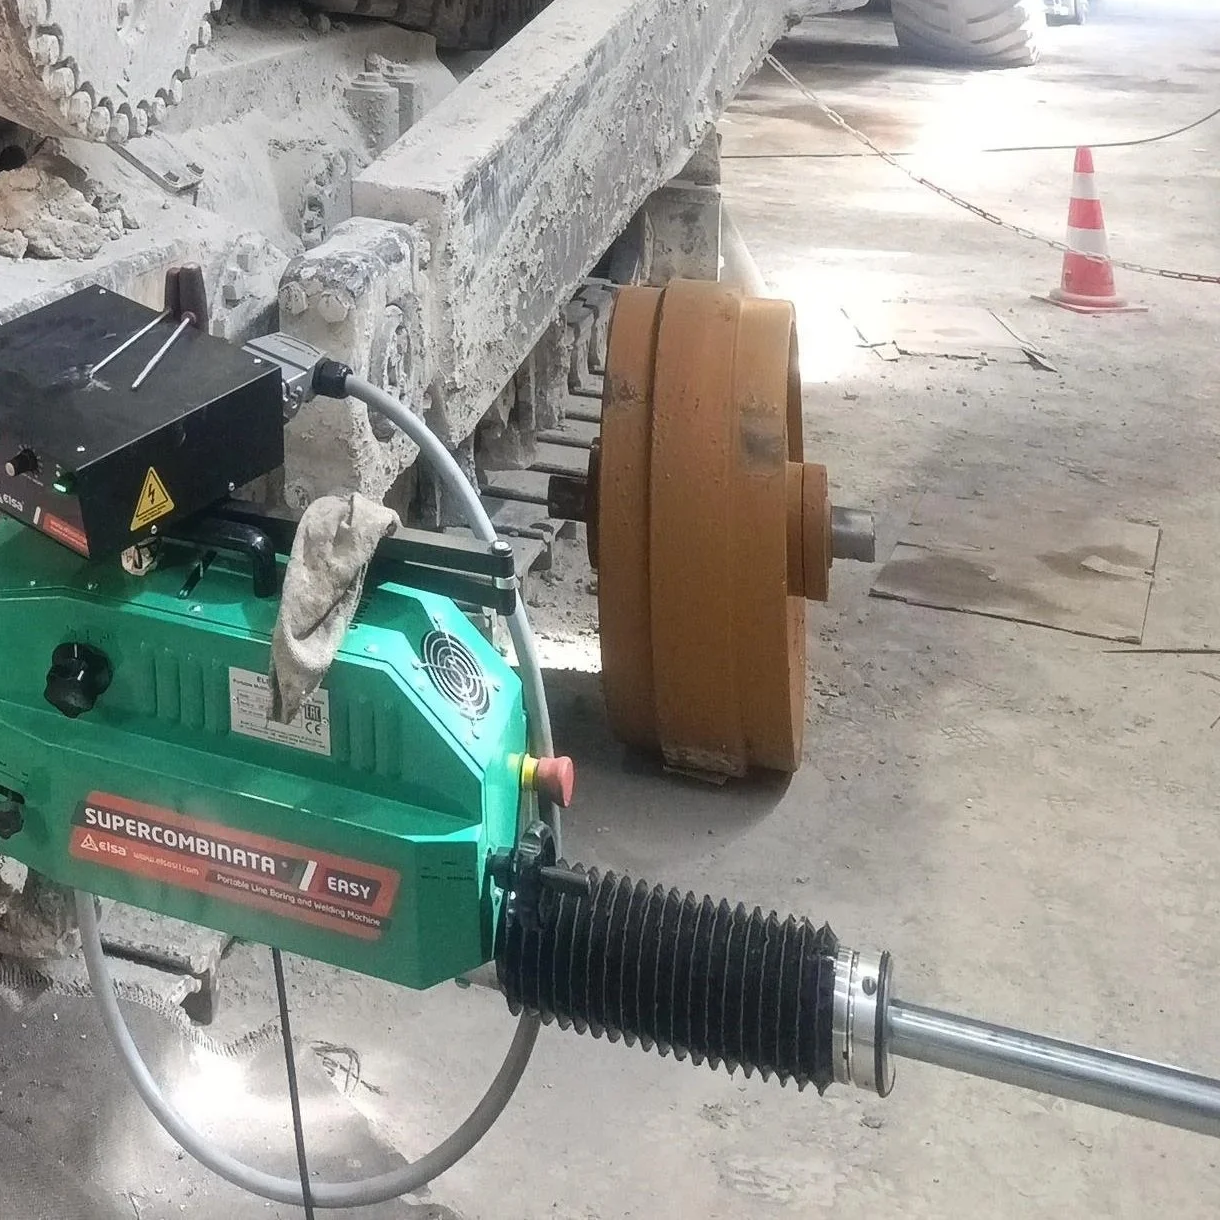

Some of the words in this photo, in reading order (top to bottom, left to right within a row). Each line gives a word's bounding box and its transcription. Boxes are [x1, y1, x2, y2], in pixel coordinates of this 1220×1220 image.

[84, 807, 276, 876] SUPERCOMBINATA
[327, 876, 371, 900] EASY
[217, 873, 250, 890] Portable
[251, 883, 268, 896] Line
[269, 888, 296, 905] Boring
[297, 897, 312, 908] and
[314, 900, 346, 918] Welding
[347, 910, 381, 927] Machine
